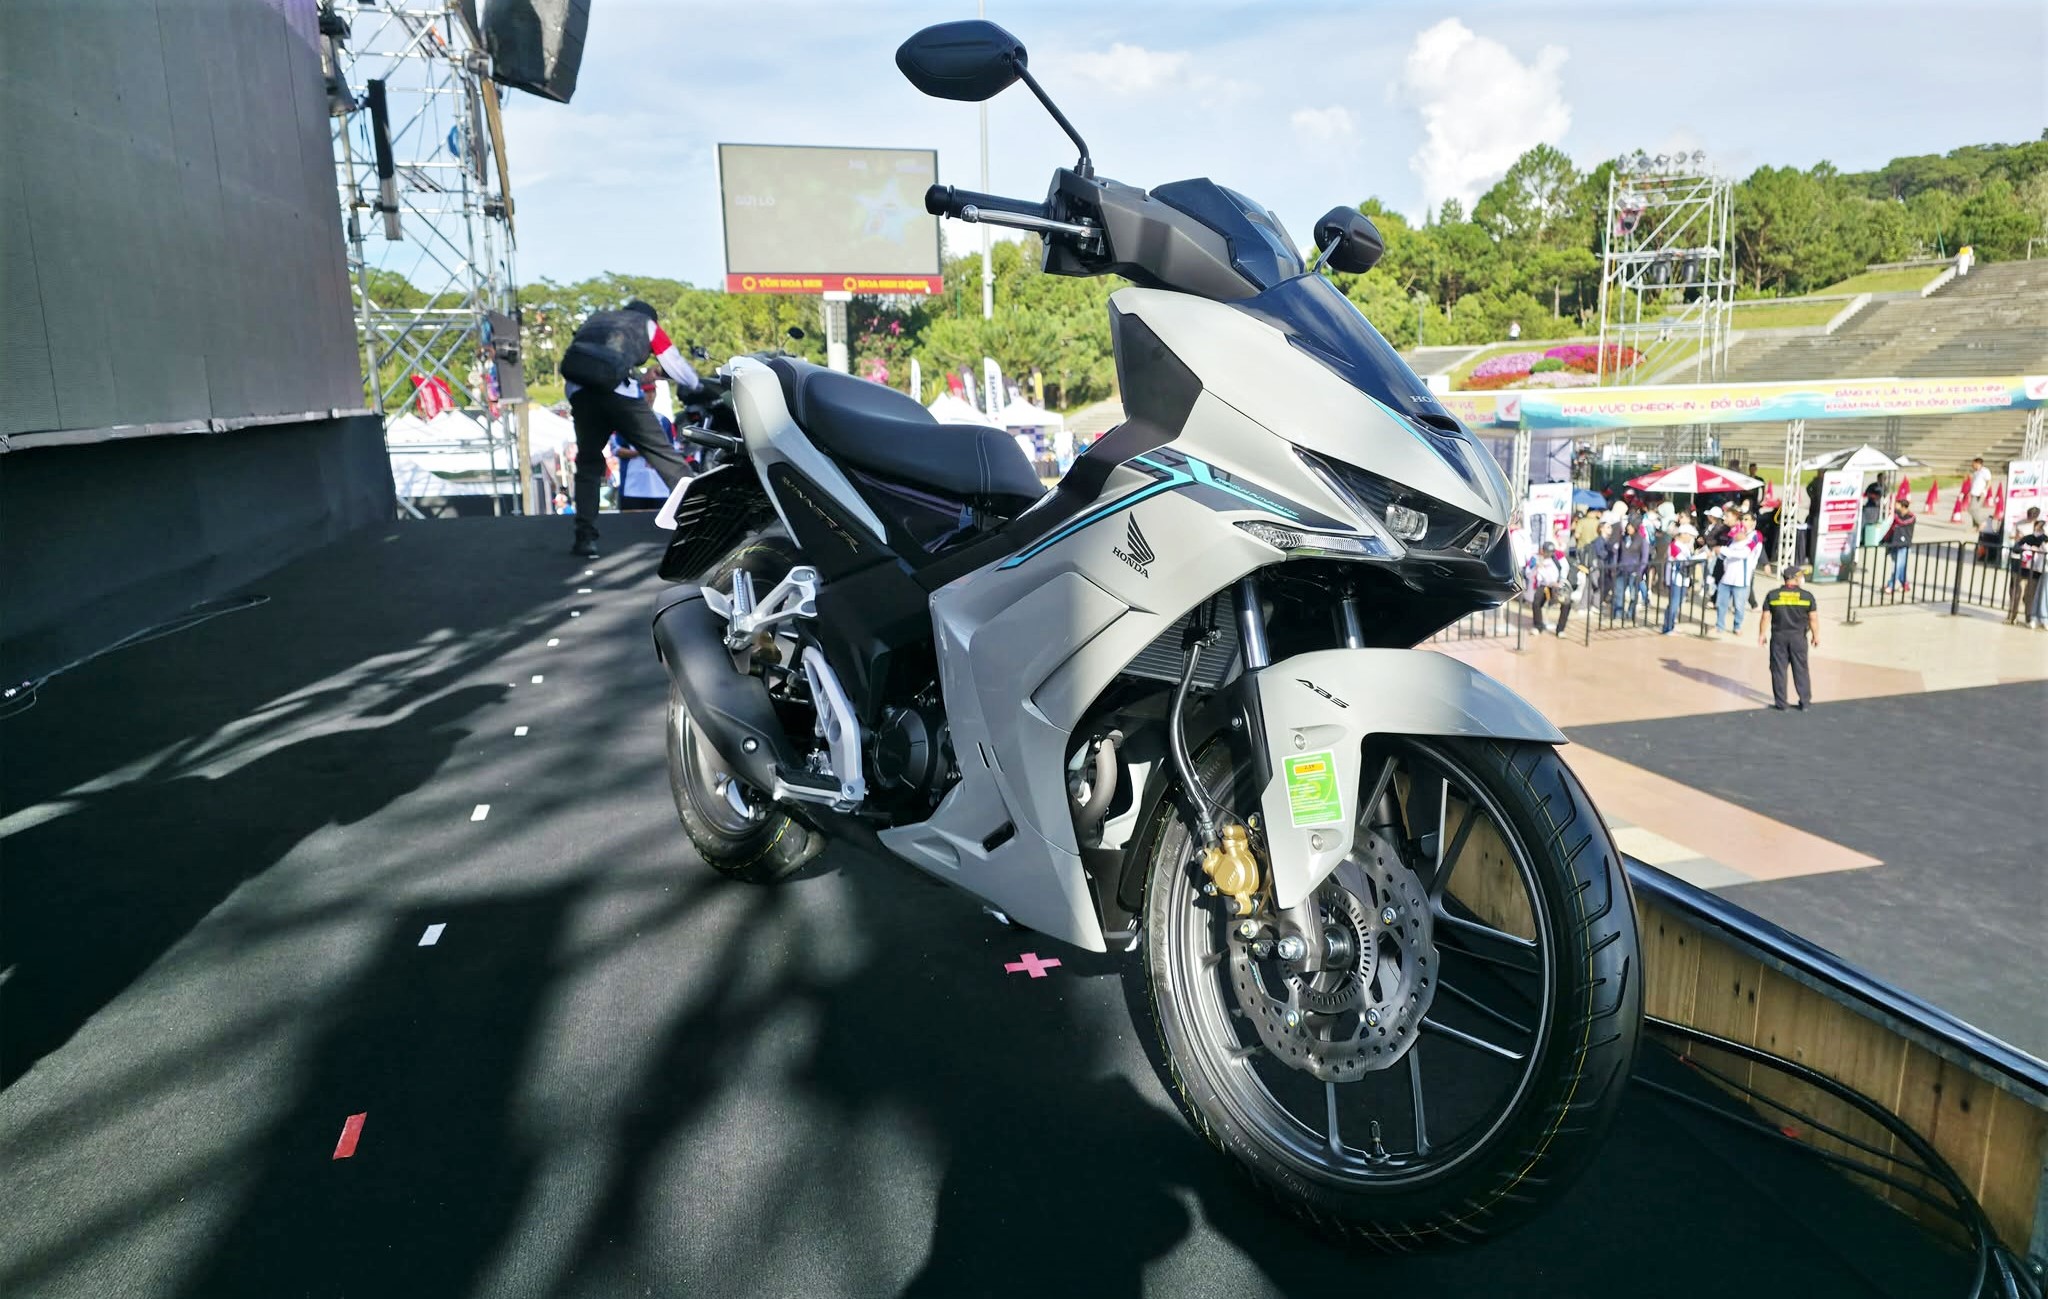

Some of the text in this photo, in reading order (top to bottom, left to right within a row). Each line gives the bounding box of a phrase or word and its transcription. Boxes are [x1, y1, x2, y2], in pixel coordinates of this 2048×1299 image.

[1563, 404, 1594, 414] KHU
[1630, 400, 1696, 413] CHECK-IN
[1112, 546, 1149, 579] HONDA
[1295, 678, 1350, 709] ABS
